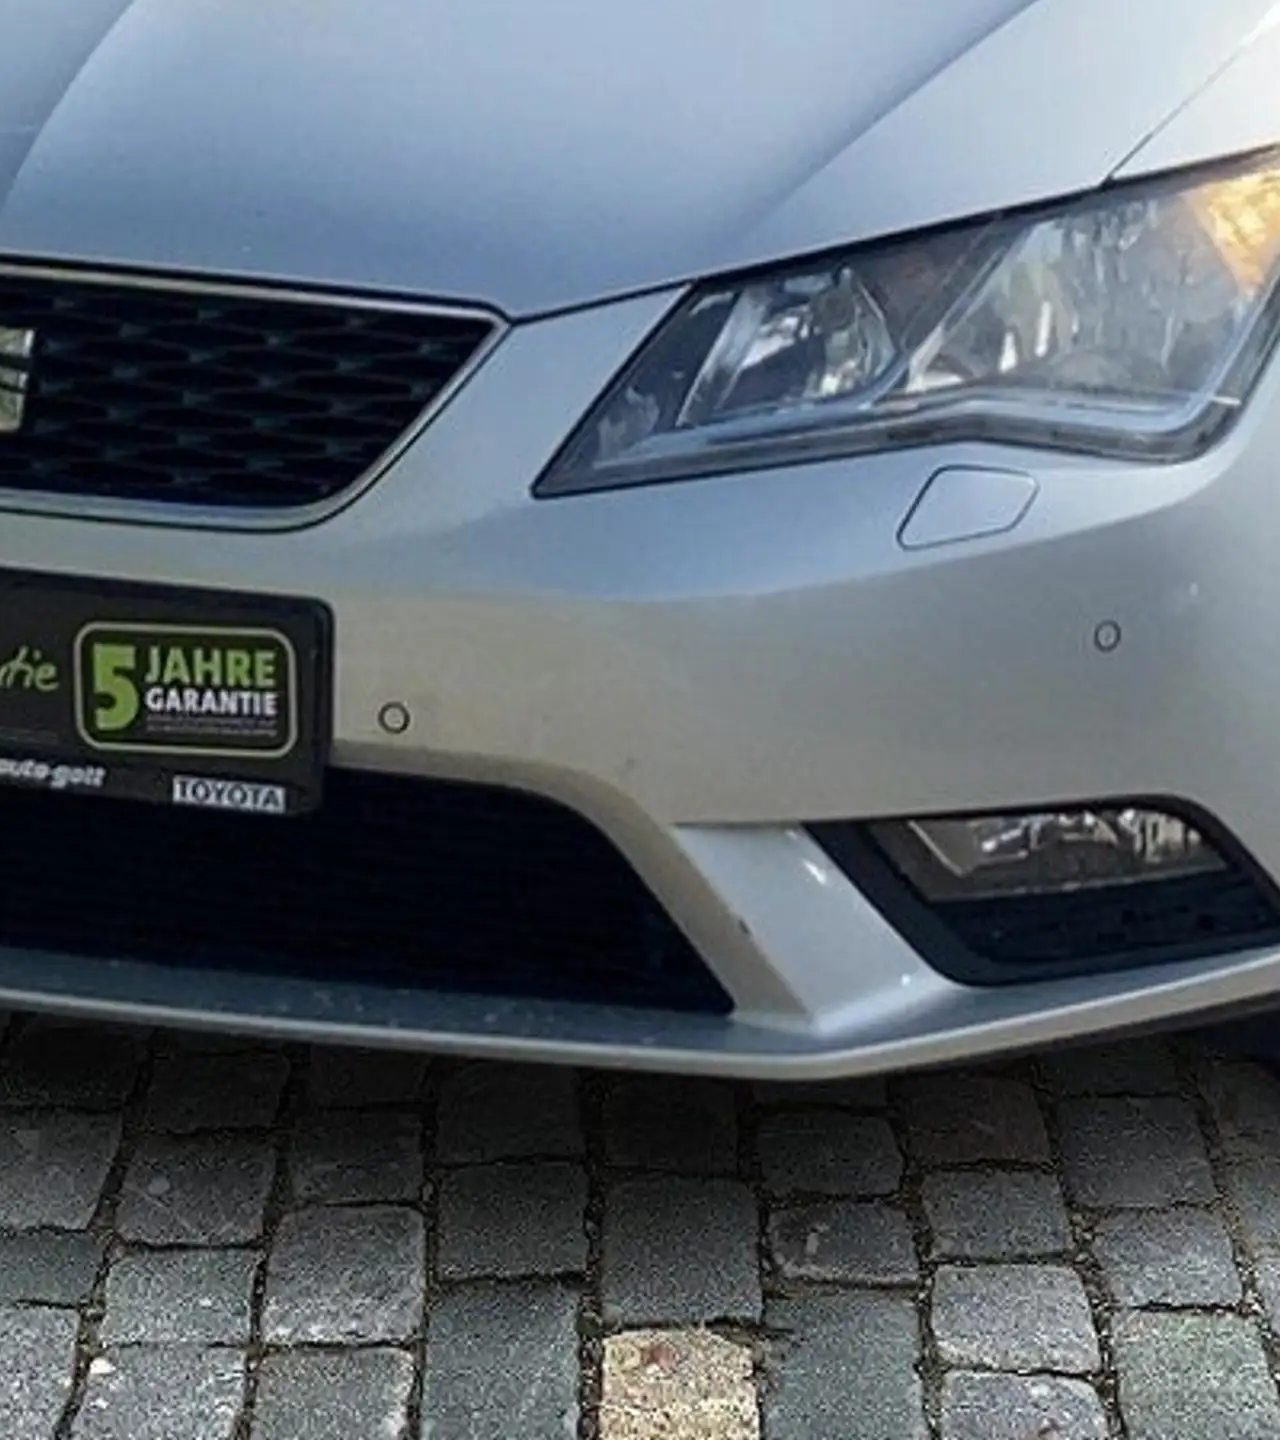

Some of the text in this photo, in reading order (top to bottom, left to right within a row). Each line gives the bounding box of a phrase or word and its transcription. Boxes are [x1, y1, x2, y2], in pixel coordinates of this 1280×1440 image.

[93, 642, 139, 730] 5
[144, 644, 277, 688] JAHRE
[144, 687, 280, 716] GARANTIE
[174, 777, 284, 813] TOYOTA
